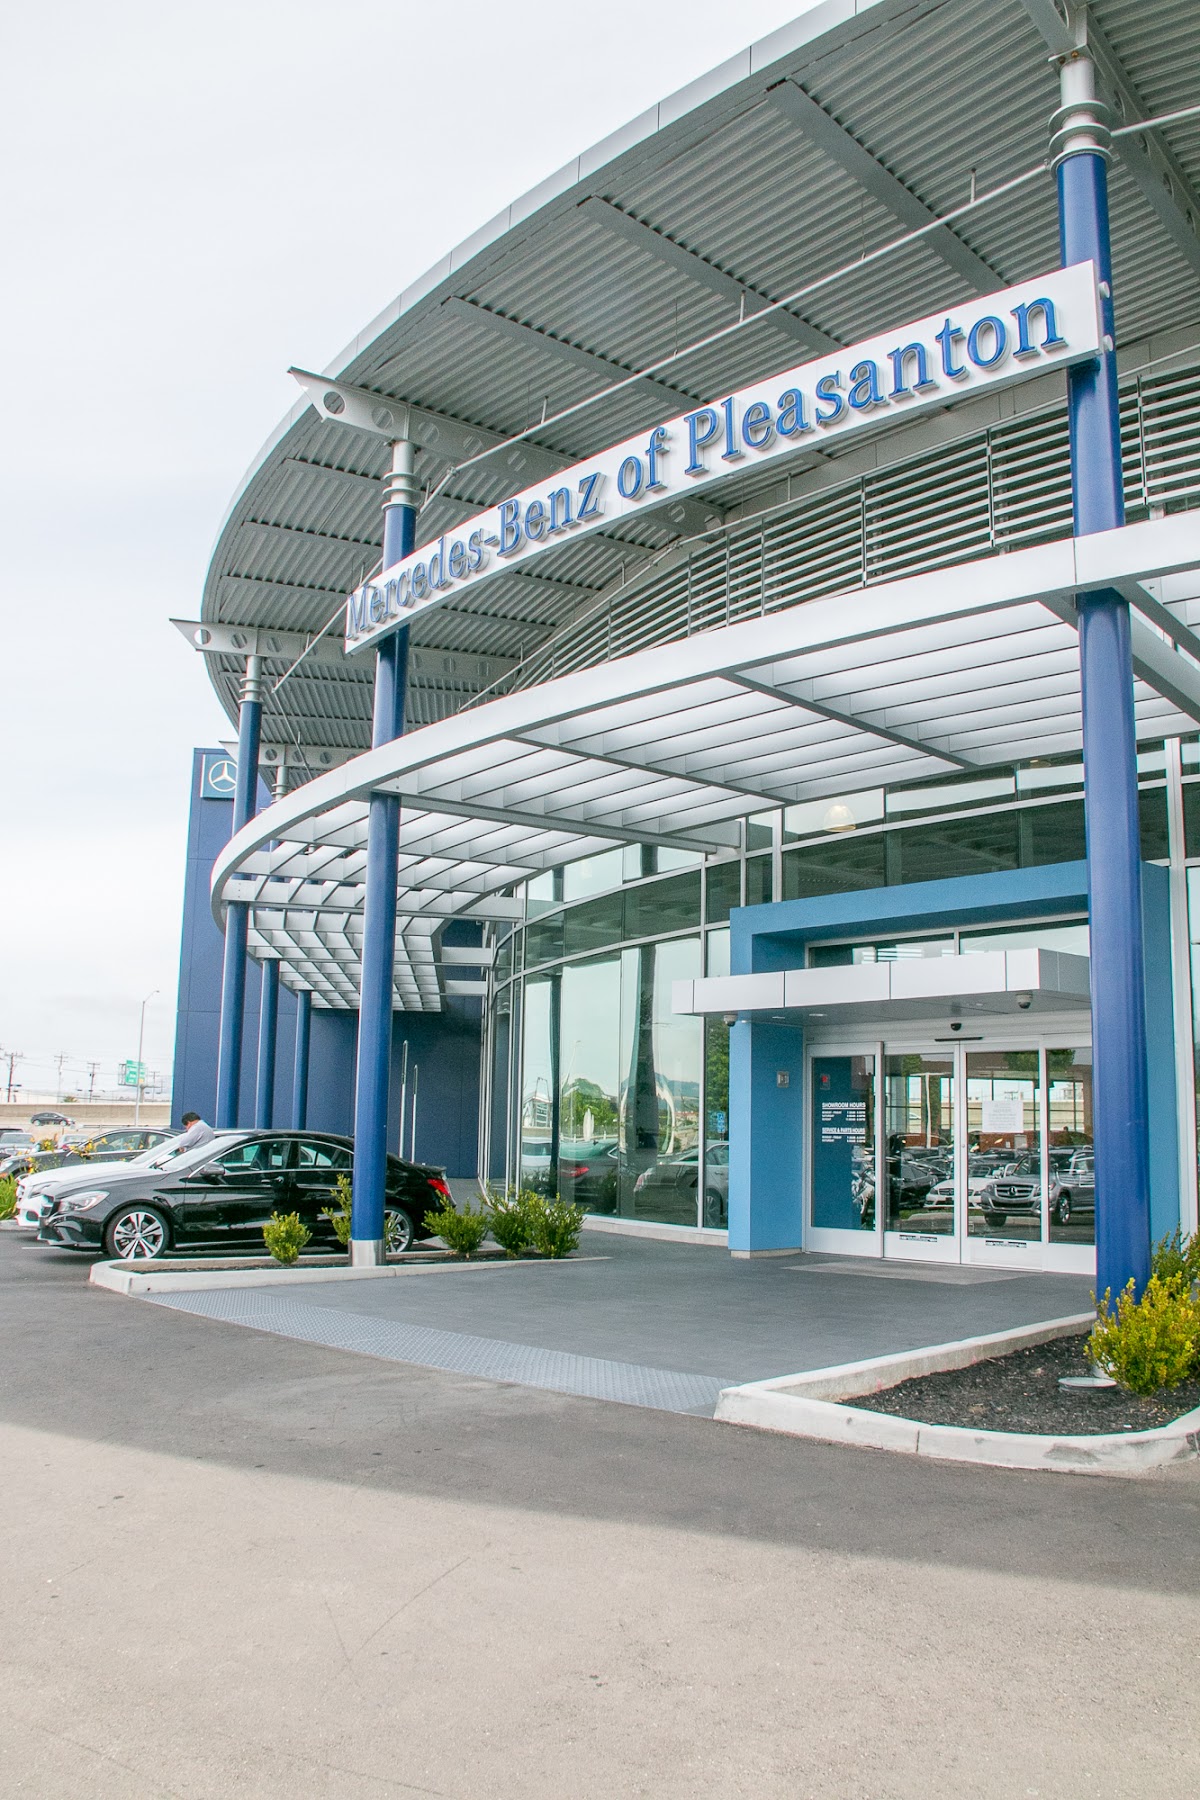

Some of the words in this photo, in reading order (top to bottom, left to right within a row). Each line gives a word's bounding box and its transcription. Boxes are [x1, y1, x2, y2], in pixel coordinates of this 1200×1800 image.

[346, 471, 607, 641] Mercedes-Benz
[617, 427, 672, 500] of
[684, 297, 1068, 477] Pleasanton
